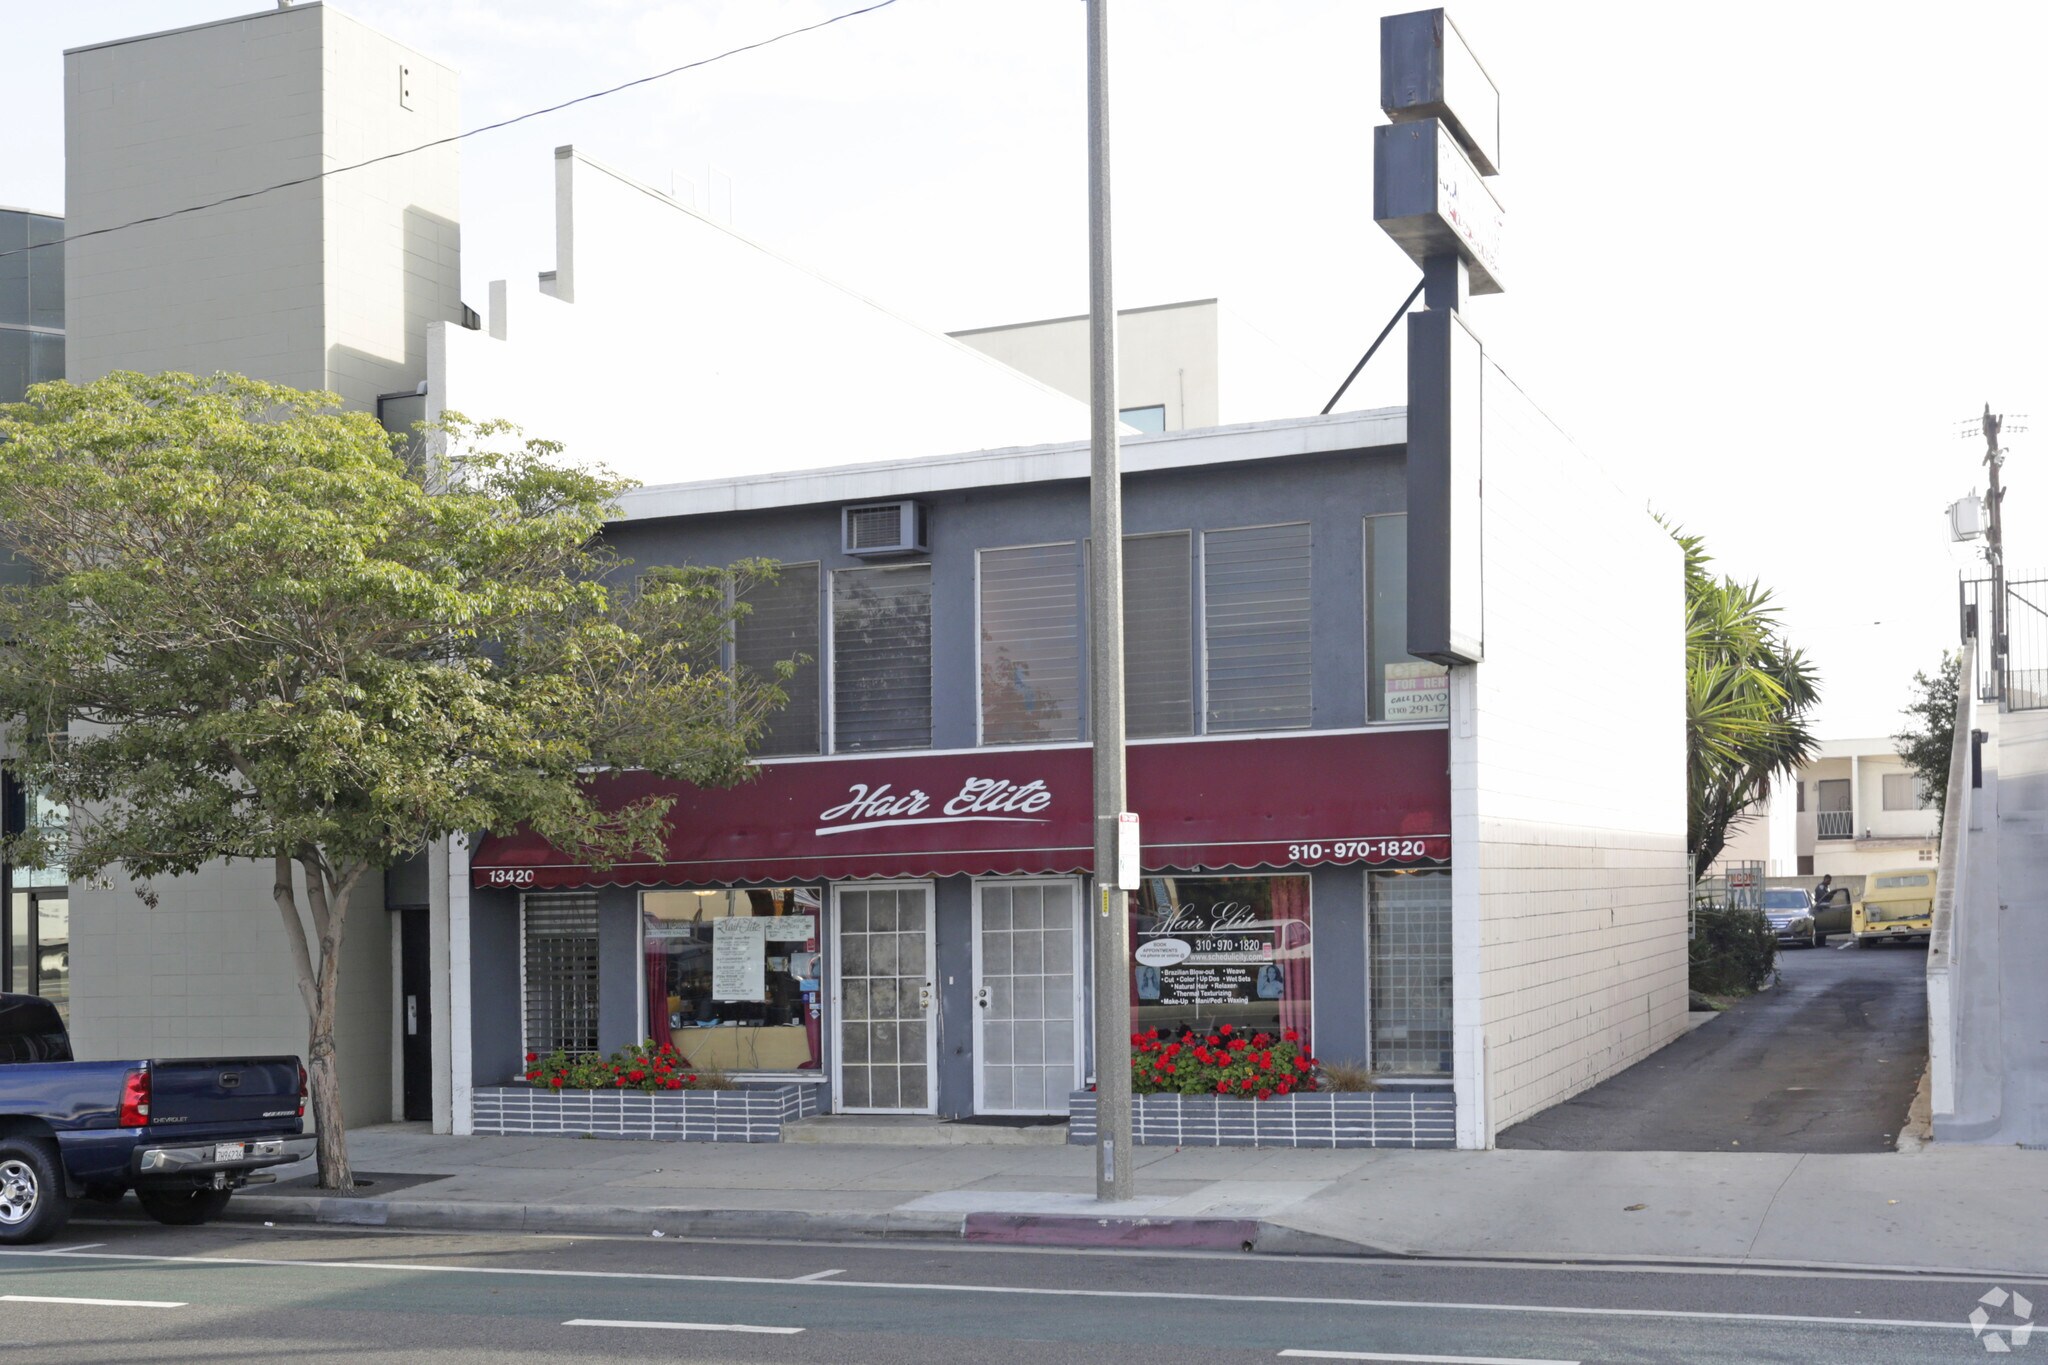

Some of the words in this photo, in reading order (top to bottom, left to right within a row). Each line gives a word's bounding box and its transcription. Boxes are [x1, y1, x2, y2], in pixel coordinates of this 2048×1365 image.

[1396, 679, 1416, 690] FOR
[1390, 695, 1411, 704] CALL
[1388, 706, 1407, 715] (310)
[1409, 703, 1449, 714] 291-17
[819, 783, 930, 821] Hair
[943, 776, 1052, 816] Elite
[1288, 840, 1426, 860] 310-970-1820
[489, 869, 535, 883] 13420
[1150, 903, 1206, 938] Hair
[1210, 901, 1260, 938] Elite
[1190, 953, 1263, 962] www.schedulicity.com
[1227, 997, 1249, 1005] Waxing
[153, 1116, 188, 1124] CHEVROLET
